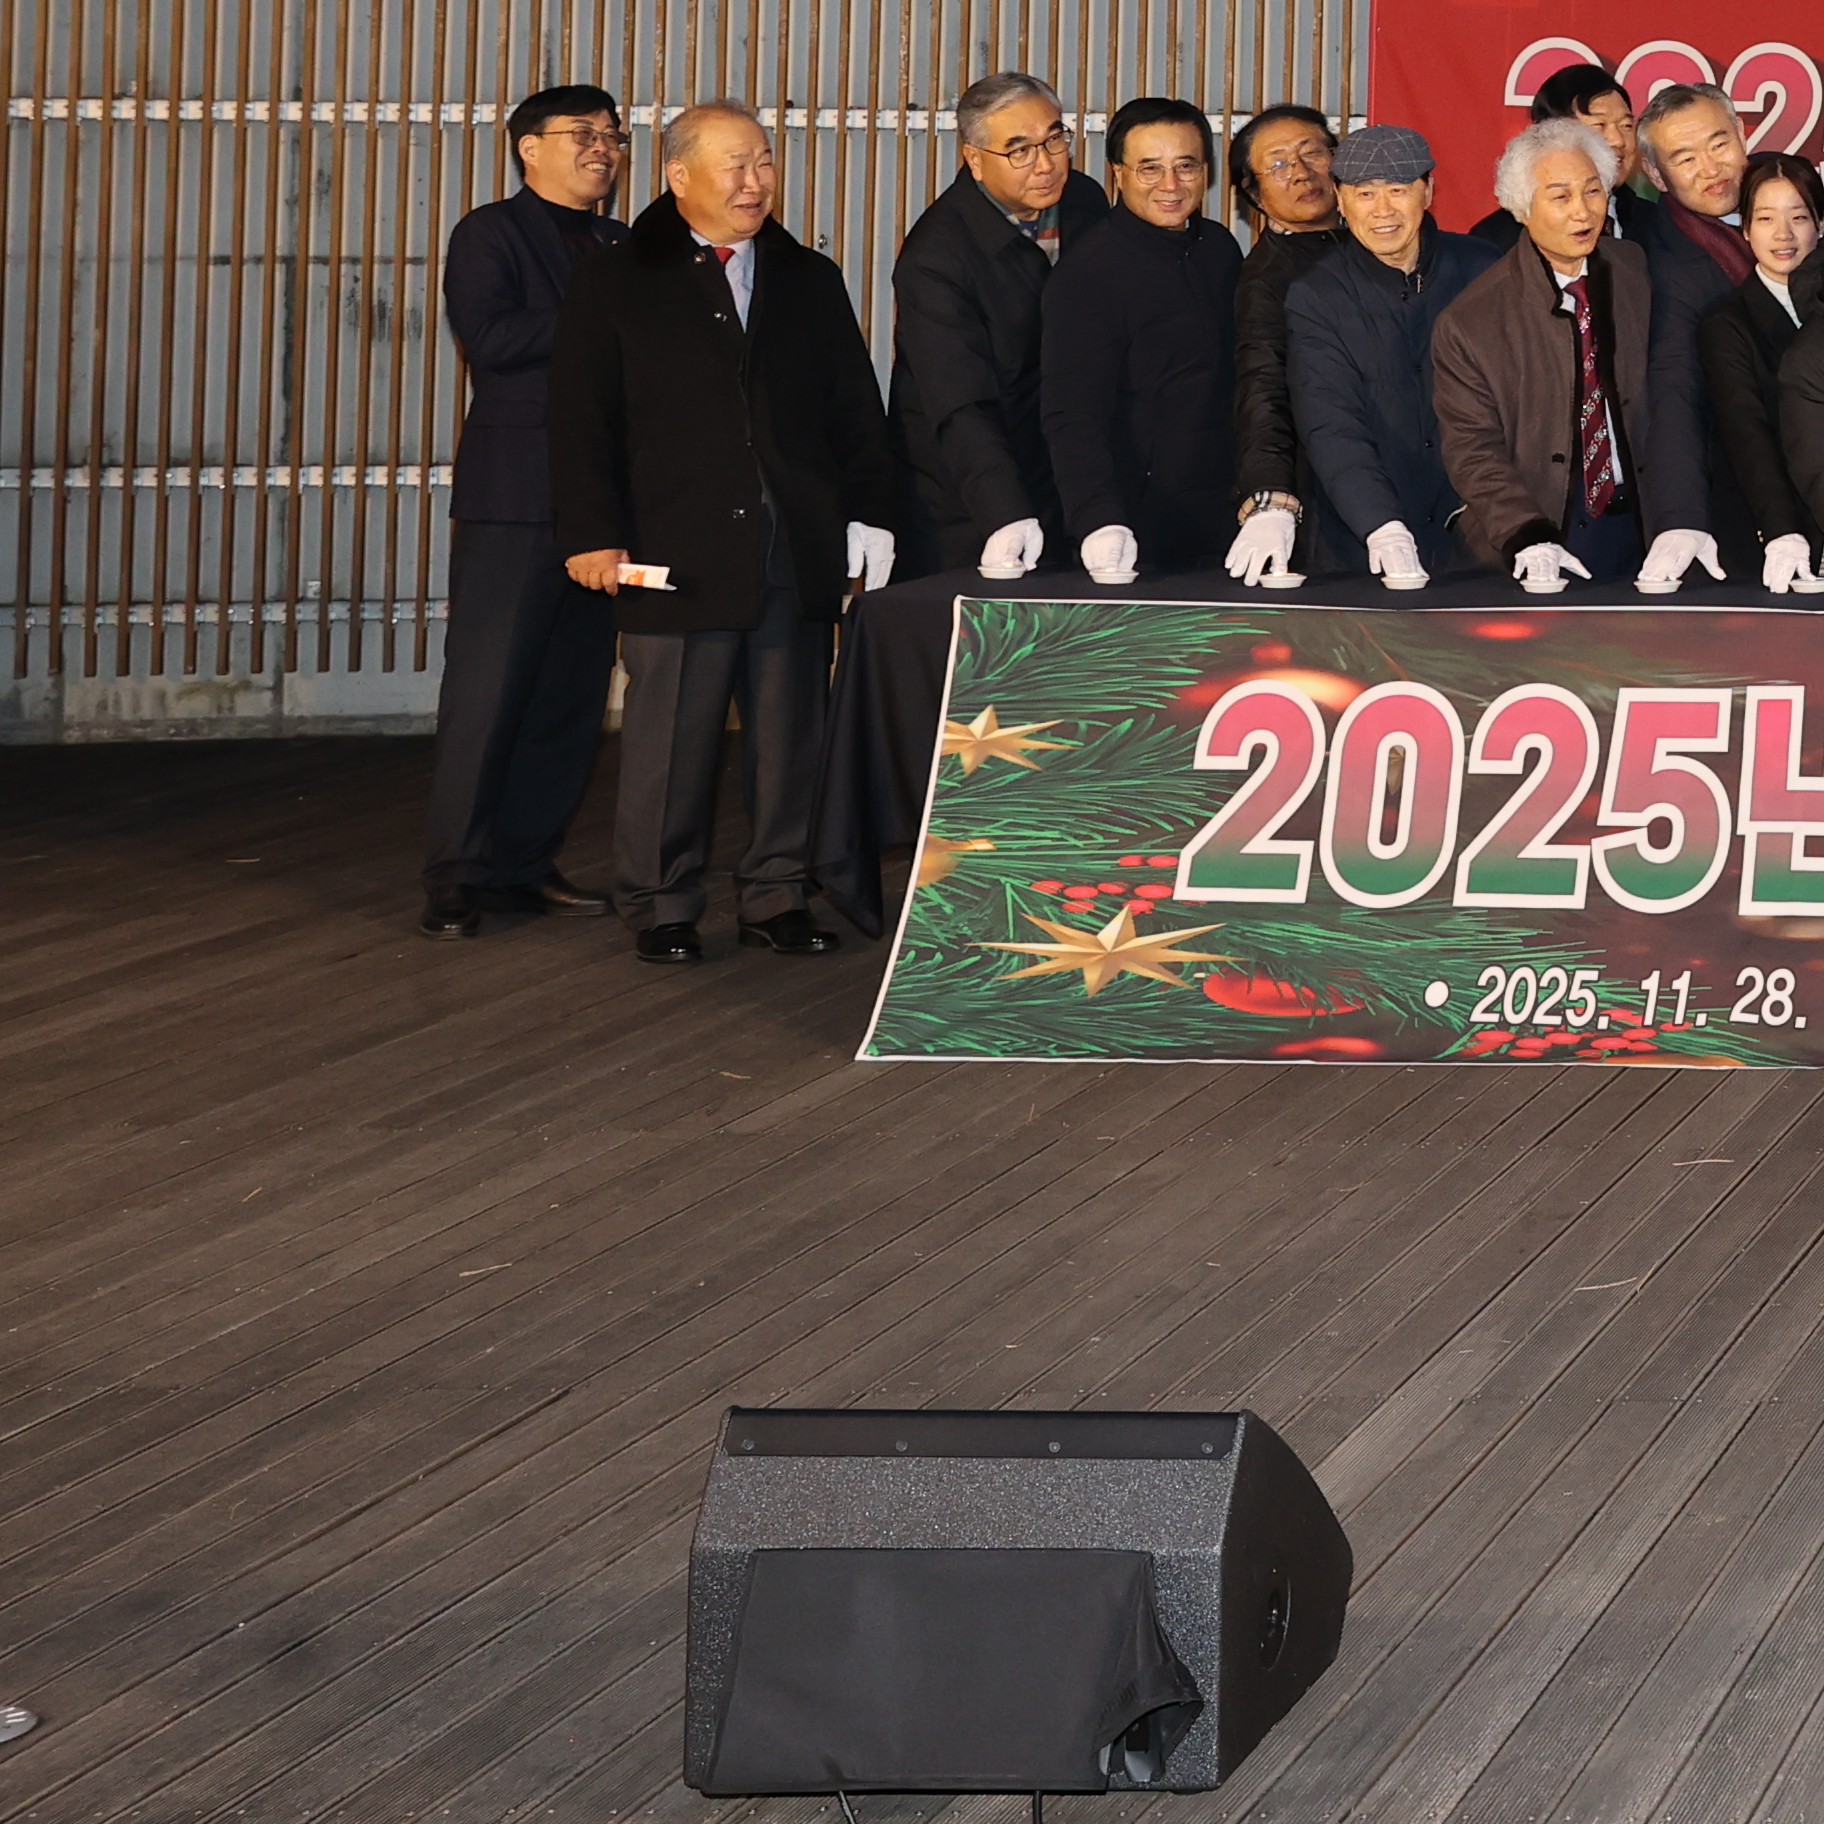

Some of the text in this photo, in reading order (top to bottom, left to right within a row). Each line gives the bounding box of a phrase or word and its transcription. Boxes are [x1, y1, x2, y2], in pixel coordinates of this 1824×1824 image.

[1470, 966, 1610, 1030] 2025.
[1640, 969, 1708, 1027] 11.
[1730, 965, 1807, 1030] 28.
